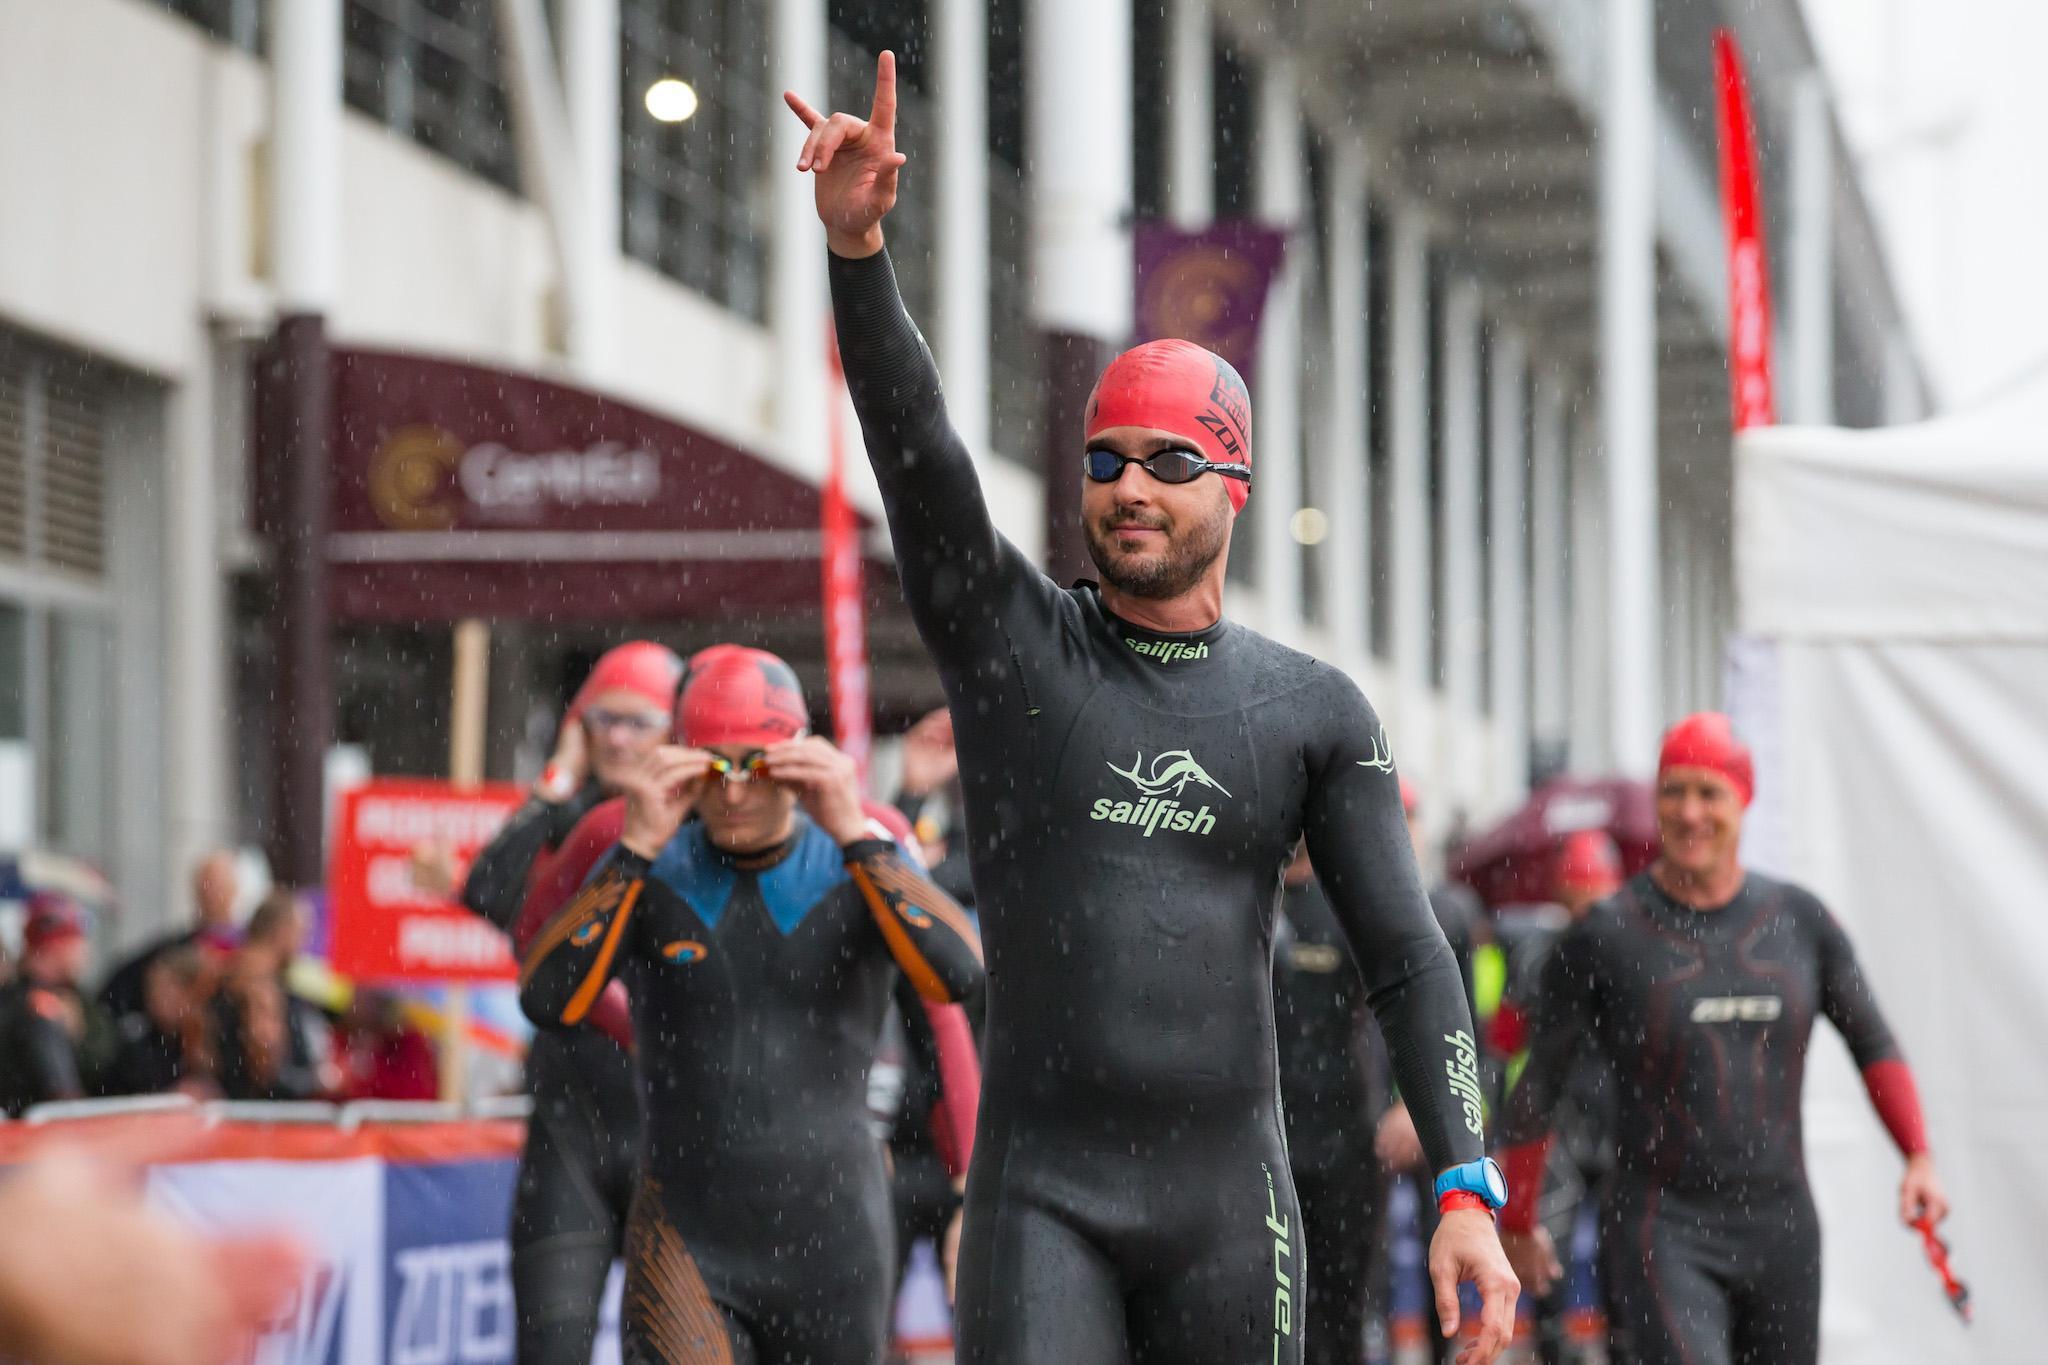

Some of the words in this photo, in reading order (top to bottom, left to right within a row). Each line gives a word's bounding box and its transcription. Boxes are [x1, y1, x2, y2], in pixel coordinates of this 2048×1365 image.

[1124, 638, 1209, 664] sailfish
[1089, 796, 1217, 838] sailfish
[1443, 1029, 1485, 1142] sailfish
[1262, 1163, 1291, 1365] ant
